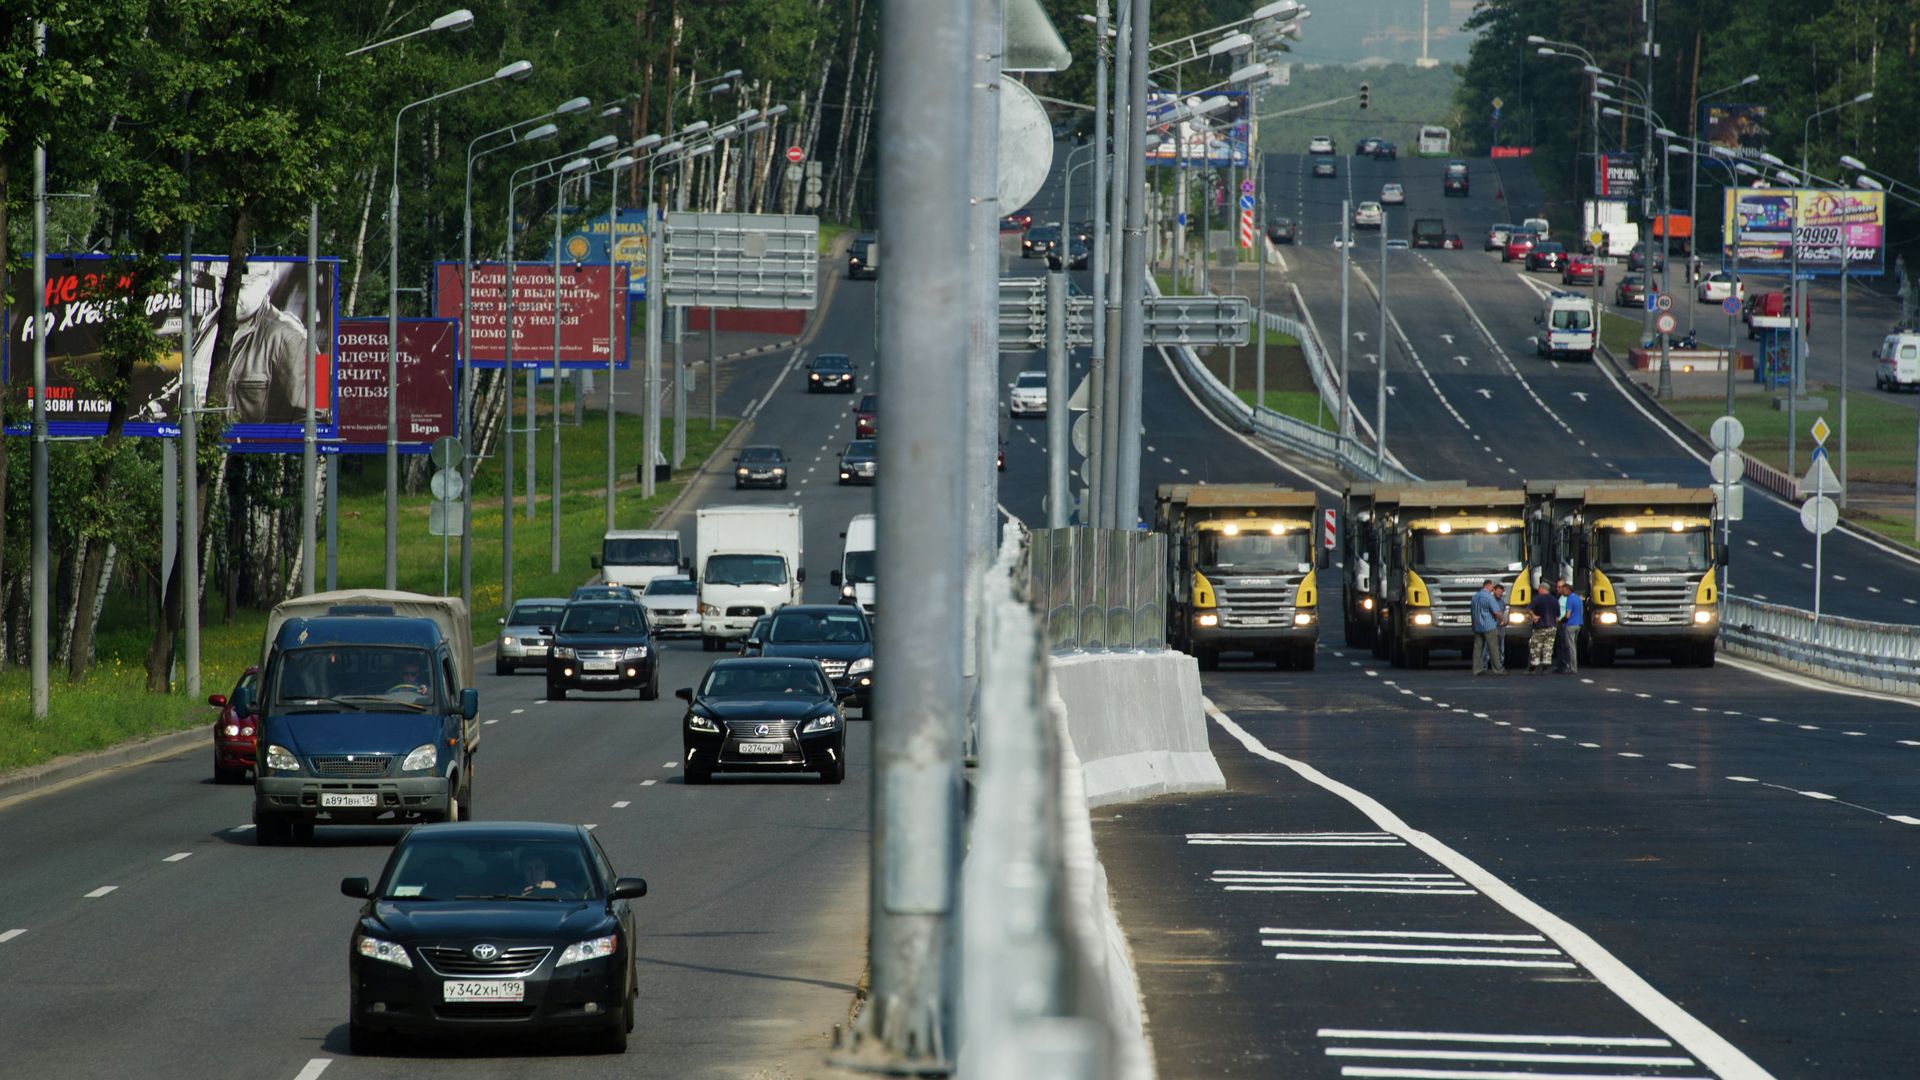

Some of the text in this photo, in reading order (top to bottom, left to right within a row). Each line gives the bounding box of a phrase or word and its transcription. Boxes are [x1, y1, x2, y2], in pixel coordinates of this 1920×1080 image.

[28, 386, 74, 398] ВПИЛ?
[27, 399, 112, 412] ВЗОВИ ТАКСИ
[411, 423, 440, 434] Вера
[325, 796, 360, 805] А891ВН
[448, 982, 520, 996] У342ХН 199
